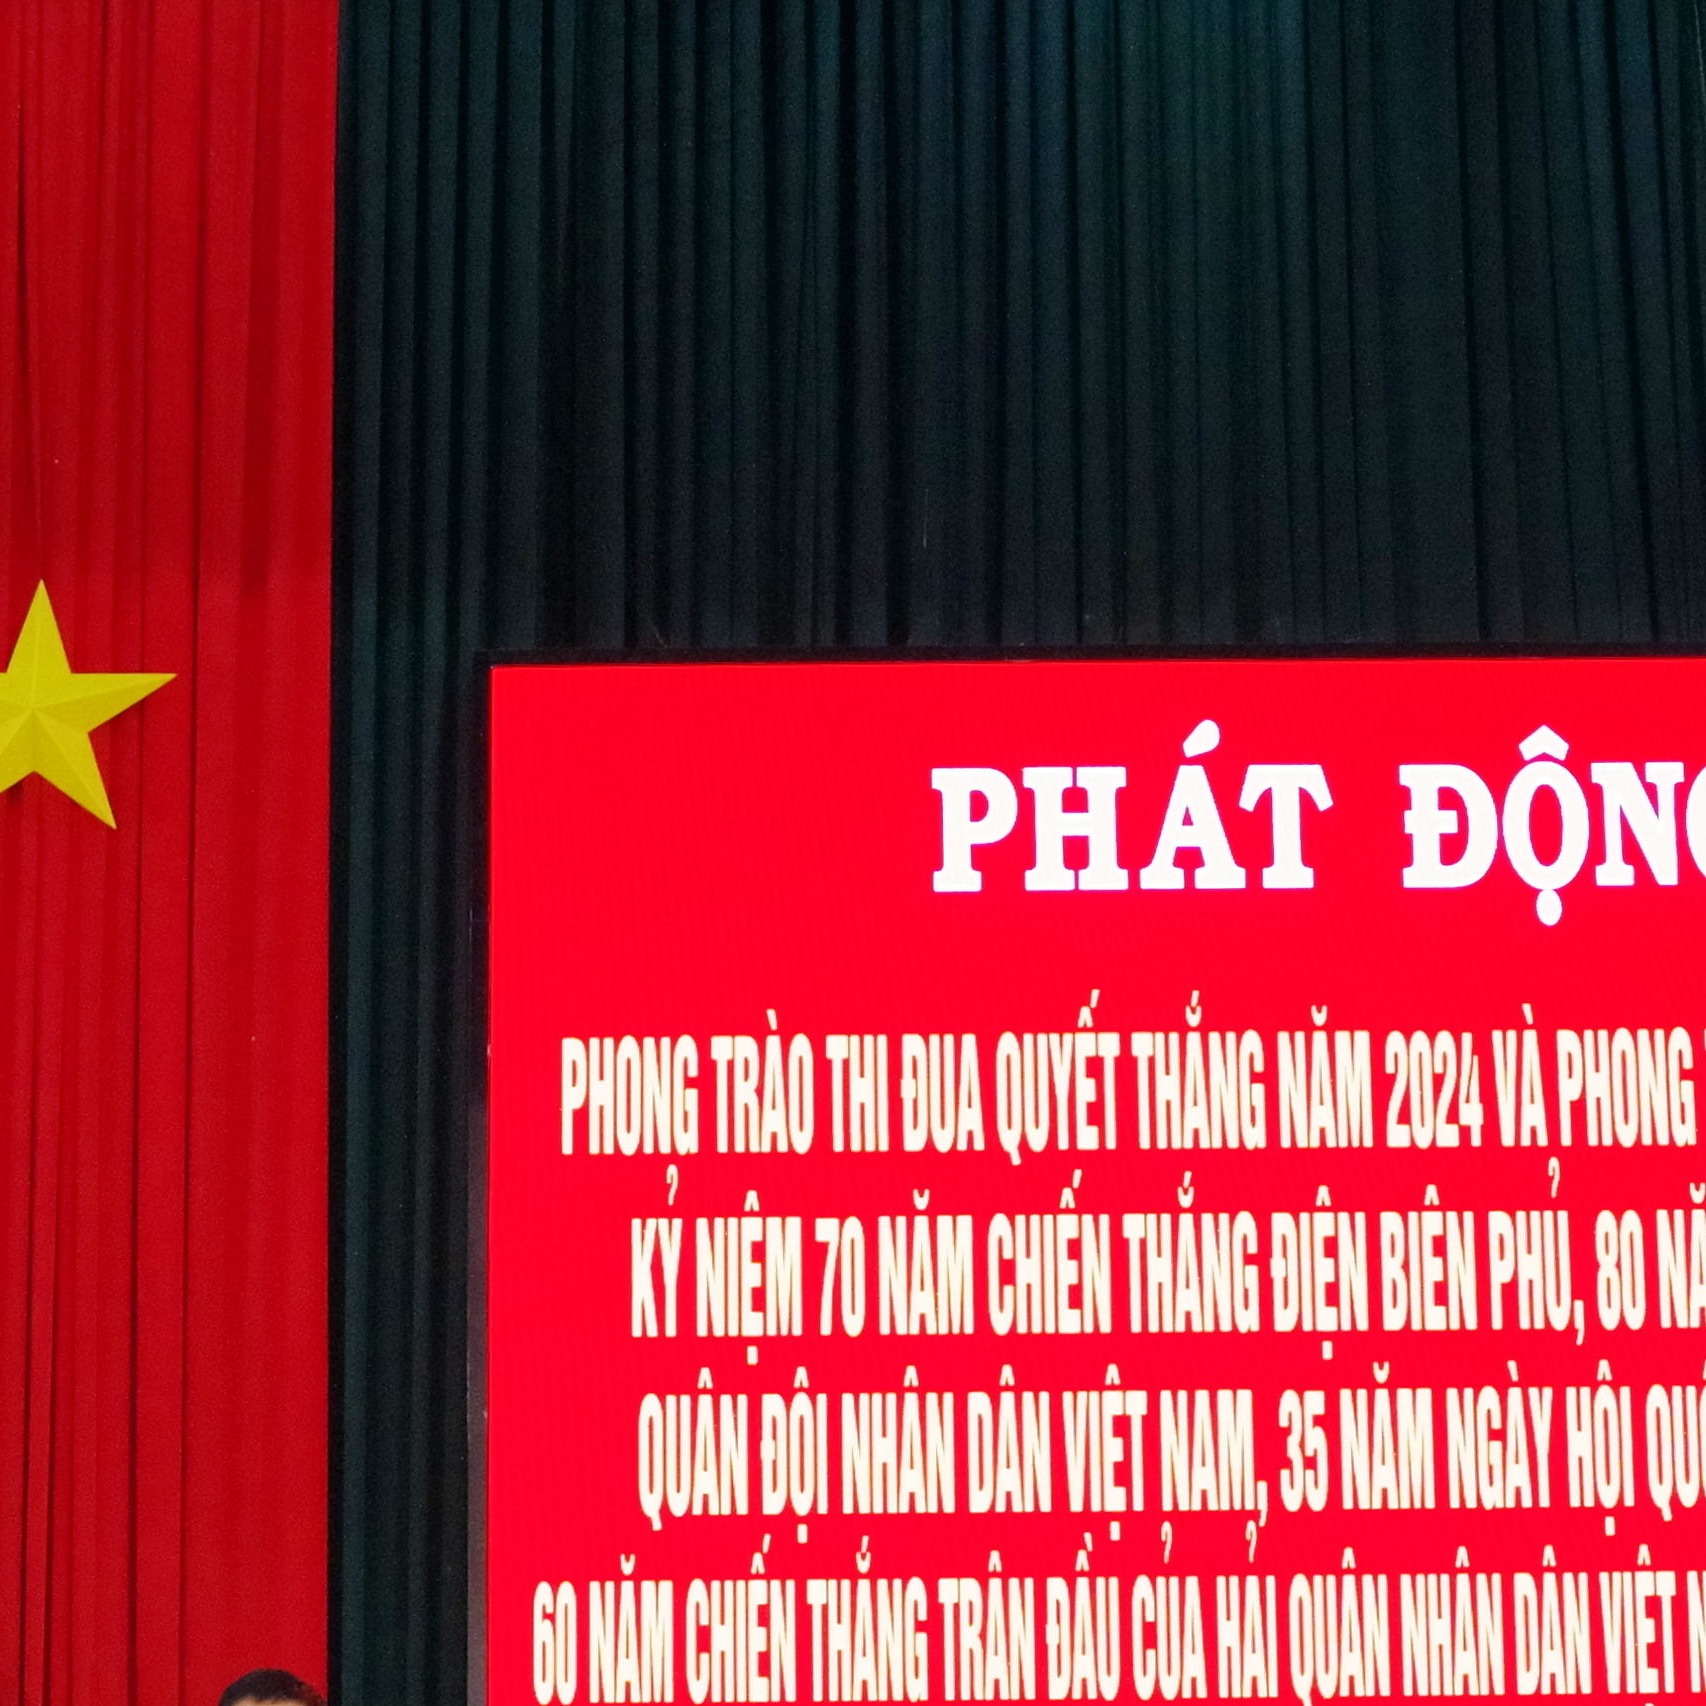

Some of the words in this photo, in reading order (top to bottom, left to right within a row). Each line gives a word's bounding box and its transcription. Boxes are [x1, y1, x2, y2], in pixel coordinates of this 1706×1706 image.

[932, 720, 1333, 892] PHÁT
[561, 1035, 698, 1156] PHONG
[711, 1009, 814, 1154] TRÀO
[826, 1034, 889, 1152] THI
[901, 1034, 985, 1153] ĐUA
[996, 989, 1120, 1165] QUYẾT
[1131, 990, 1266, 1150] THẮNG
[1277, 1005, 1373, 1148] NĂM
[1385, 1030, 1483, 1149] 2024
[1492, 1003, 1548, 1147] VÀ
[1557, 1027, 1697, 1147] PHONG
[631, 1164, 682, 1337] KỶ
[696, 1190, 802, 1365] NIỆM
[815, 1216, 865, 1337] 70
[878, 1189, 974, 1335] NĂM
[988, 1169, 1111, 1336] CHIẾN
[1123, 1171, 1260, 1333] THẮNG
[1270, 1185, 1368, 1360] ĐIỆN
[1380, 1184, 1477, 1331] BIÊN
[1488, 1157, 1584, 1345] PHỦ,
[1595, 1210, 1646, 1330] 80
[638, 1367, 748, 1531] QUÂN
[760, 1367, 828, 1553] ĐỘI
[842, 1365, 955, 1514] NHÂN
[968, 1365, 1051, 1513] DÂN
[1063, 1364, 1147, 1551] VIỆT
[1160, 1389, 1268, 1527] NAM,
[1279, 1390, 1328, 1512] 35
[1340, 1362, 1435, 1509] NĂM
[1446, 1360, 1552, 1510] NGÀY
[1566, 1359, 1634, 1536] HỘI
[533, 1581, 577, 1705] 60
[589, 1554, 674, 1703] NĂM
[686, 1524, 807, 1704] CHIẾN
[807, 1536, 928, 1702] THẮNG
[1046, 1521, 1120, 1701] ĐẦU
[1132, 1521, 1207, 1700] CỦA
[1216, 1520, 1278, 1698] HẢI
[1400, 1546, 1505, 1696] NHÂN
[1514, 1545, 1592, 1695] DÂN
